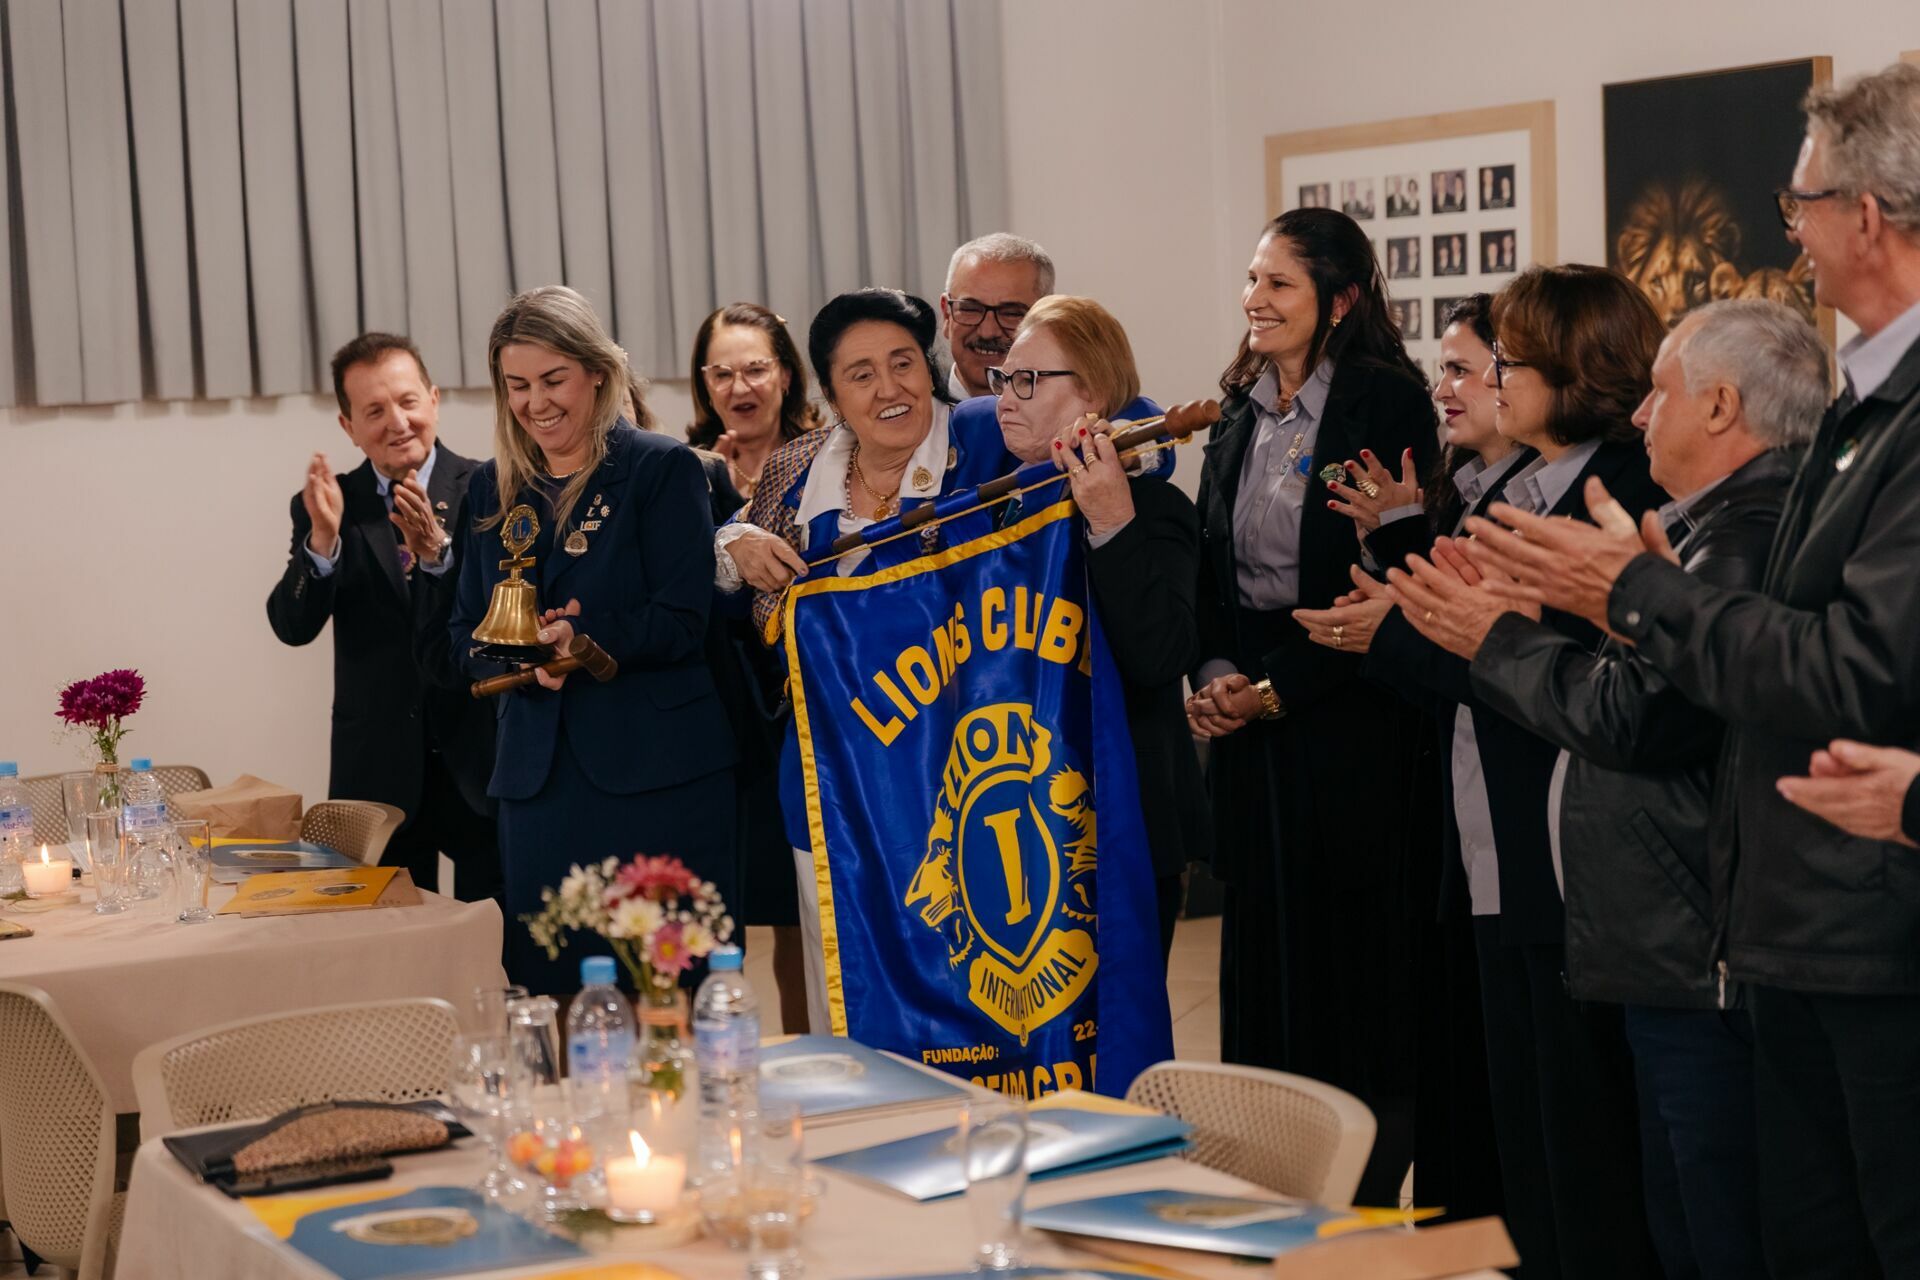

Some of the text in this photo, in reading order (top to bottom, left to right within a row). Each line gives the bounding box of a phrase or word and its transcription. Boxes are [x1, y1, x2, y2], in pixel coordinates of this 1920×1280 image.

[850, 601, 972, 747] LIONS
[980, 948, 1087, 1021] INTERNATIONAL
[922, 1043, 999, 1064] FUNDAÇÃO:
